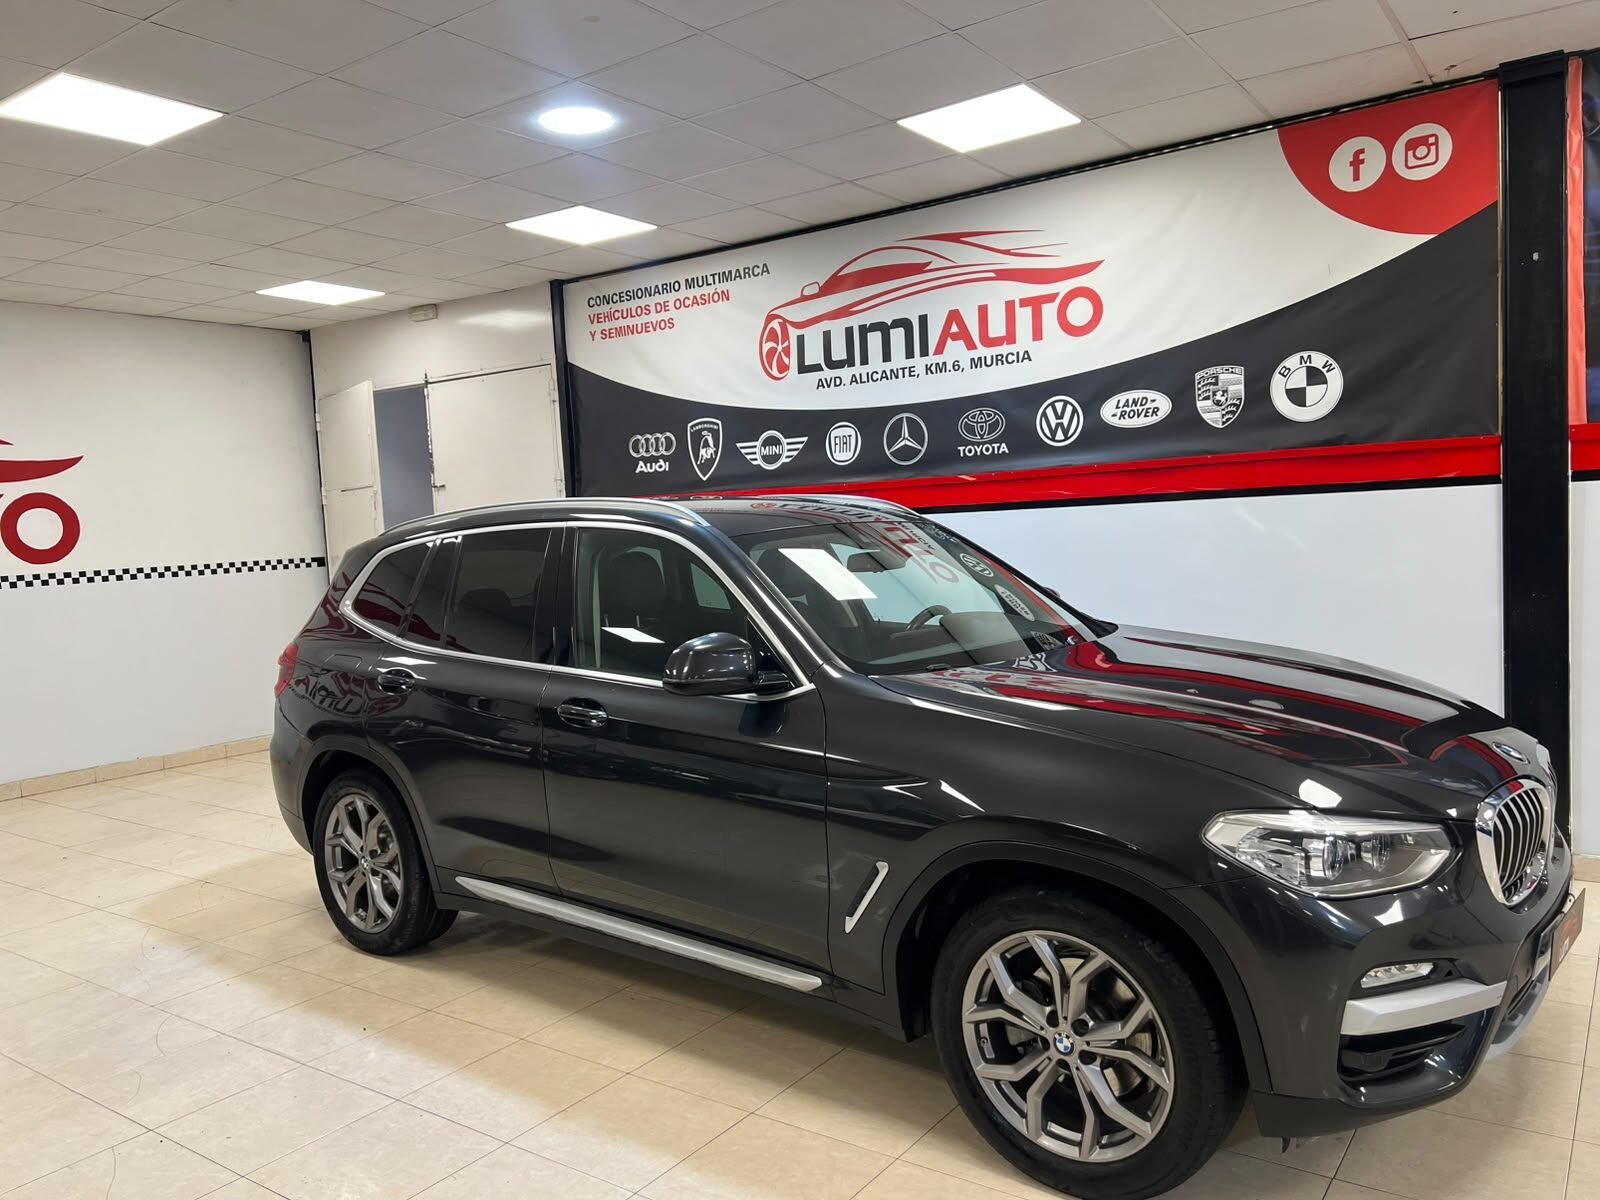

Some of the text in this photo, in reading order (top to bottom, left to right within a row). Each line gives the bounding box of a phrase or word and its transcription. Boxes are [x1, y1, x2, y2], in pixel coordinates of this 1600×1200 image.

[587, 263, 771, 309] CONCESIONARIO MULTIMARCA
[588, 288, 731, 325] VEHÍCULOS DE OCASIÓN
[589, 318, 675, 342] Y SEMINUEVOS
[816, 350, 1033, 390] AVD. ALICANTE, KM.6, MURCIA
[1197, 366, 1243, 379] PORSCHE
[1278, 354, 1336, 379] BMW
[760, 445, 783, 456] MINI
[833, 434, 853, 454] FIAT
[957, 442, 1009, 457] TOYOTA
[635, 459, 670, 474] Audi
